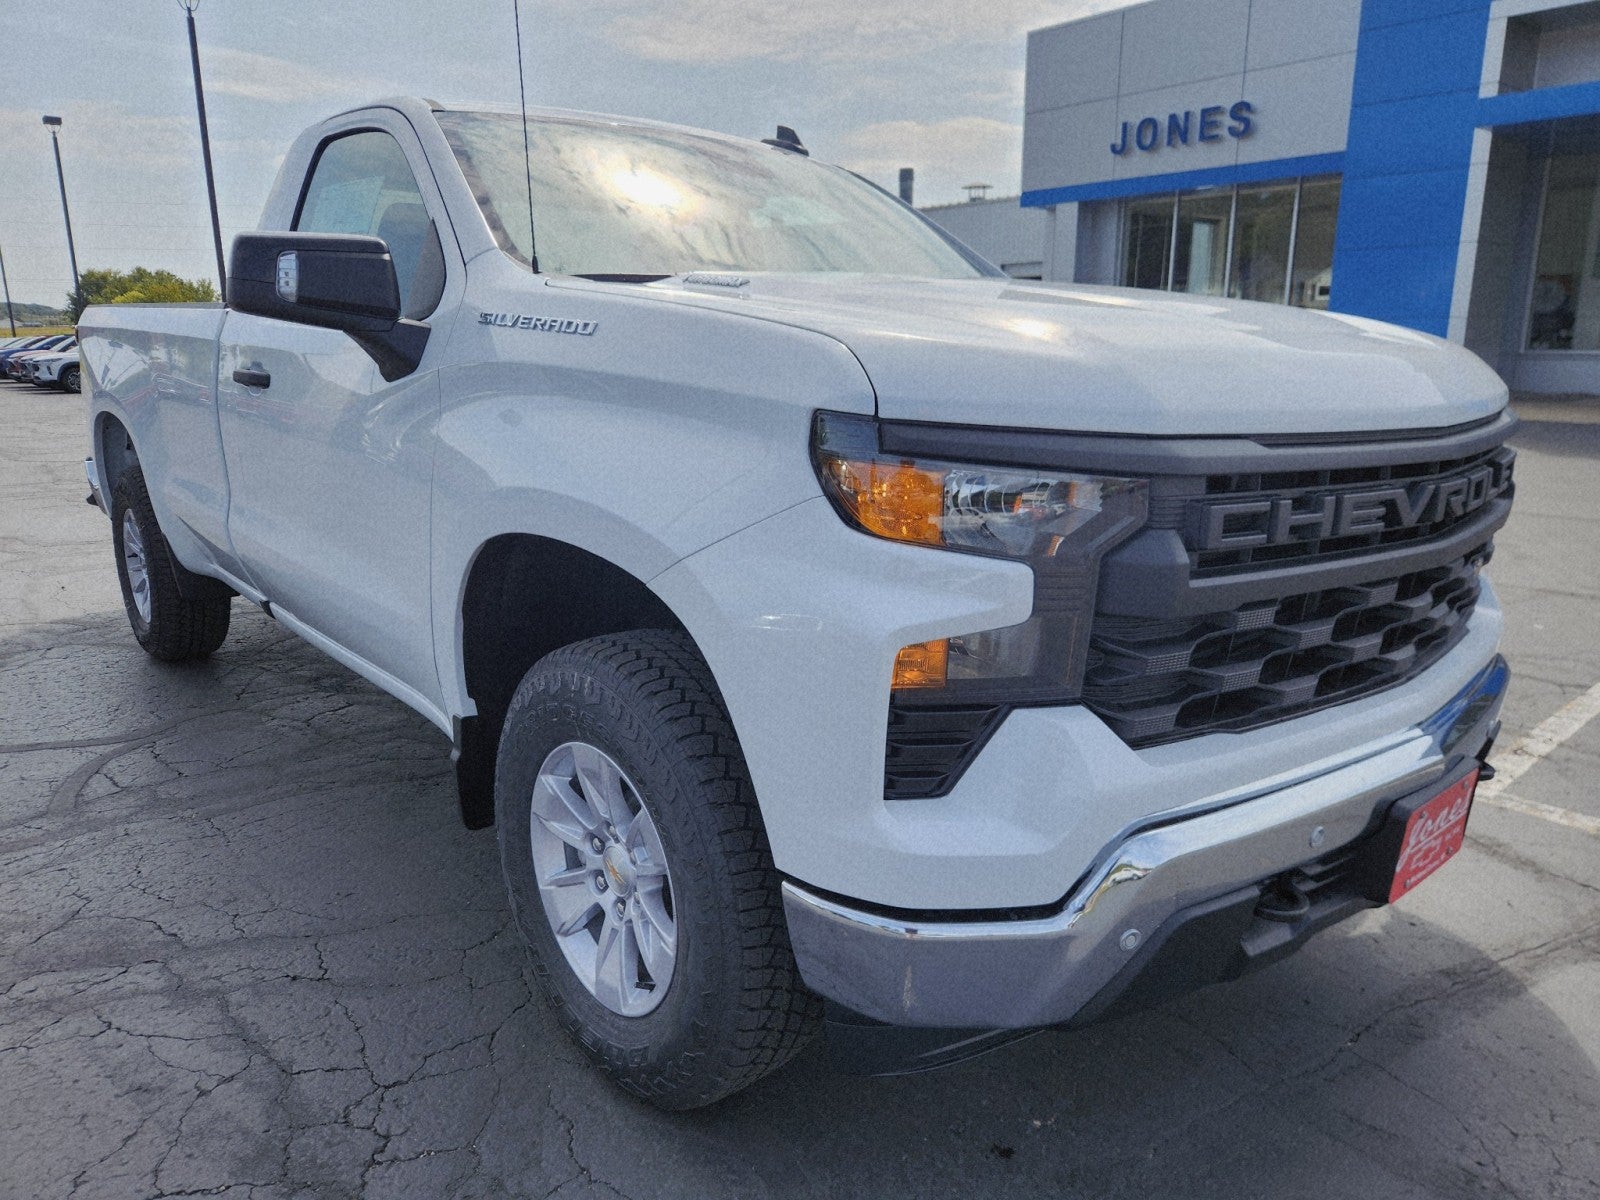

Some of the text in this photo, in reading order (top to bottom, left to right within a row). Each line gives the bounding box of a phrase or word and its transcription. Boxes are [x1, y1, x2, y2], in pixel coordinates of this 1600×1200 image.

[1110, 101, 1254, 155] JONES
[478, 311, 598, 336] SILVERADO
[1202, 450, 1517, 550] CHEVROLE
